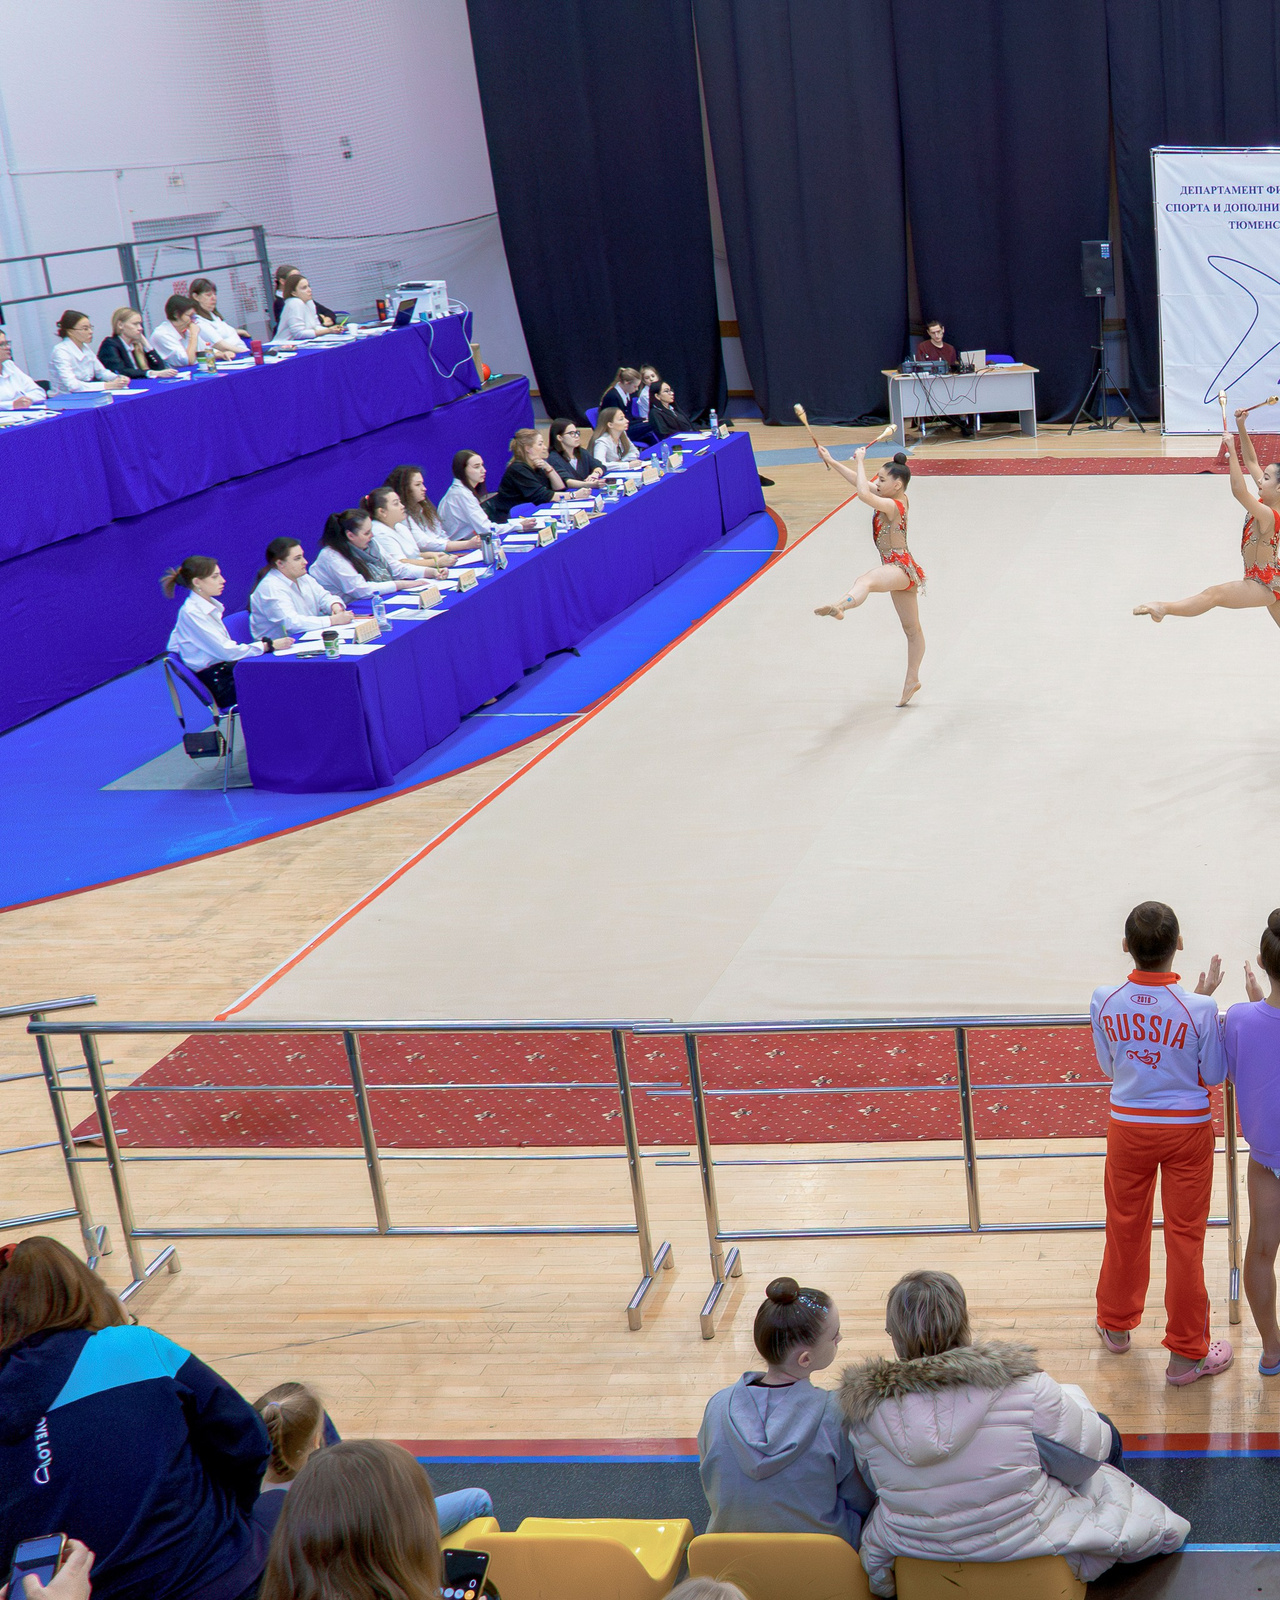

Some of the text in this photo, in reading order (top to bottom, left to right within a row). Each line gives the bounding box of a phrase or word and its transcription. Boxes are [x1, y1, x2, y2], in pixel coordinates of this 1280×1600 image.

[1180, 185, 1264, 196] ДЕПАРТАМЕНТ
[1165, 202, 1210, 213] СПОРТА
[1213, 202, 1222, 213] И
[1103, 1013, 1188, 1049] RUSSIA
